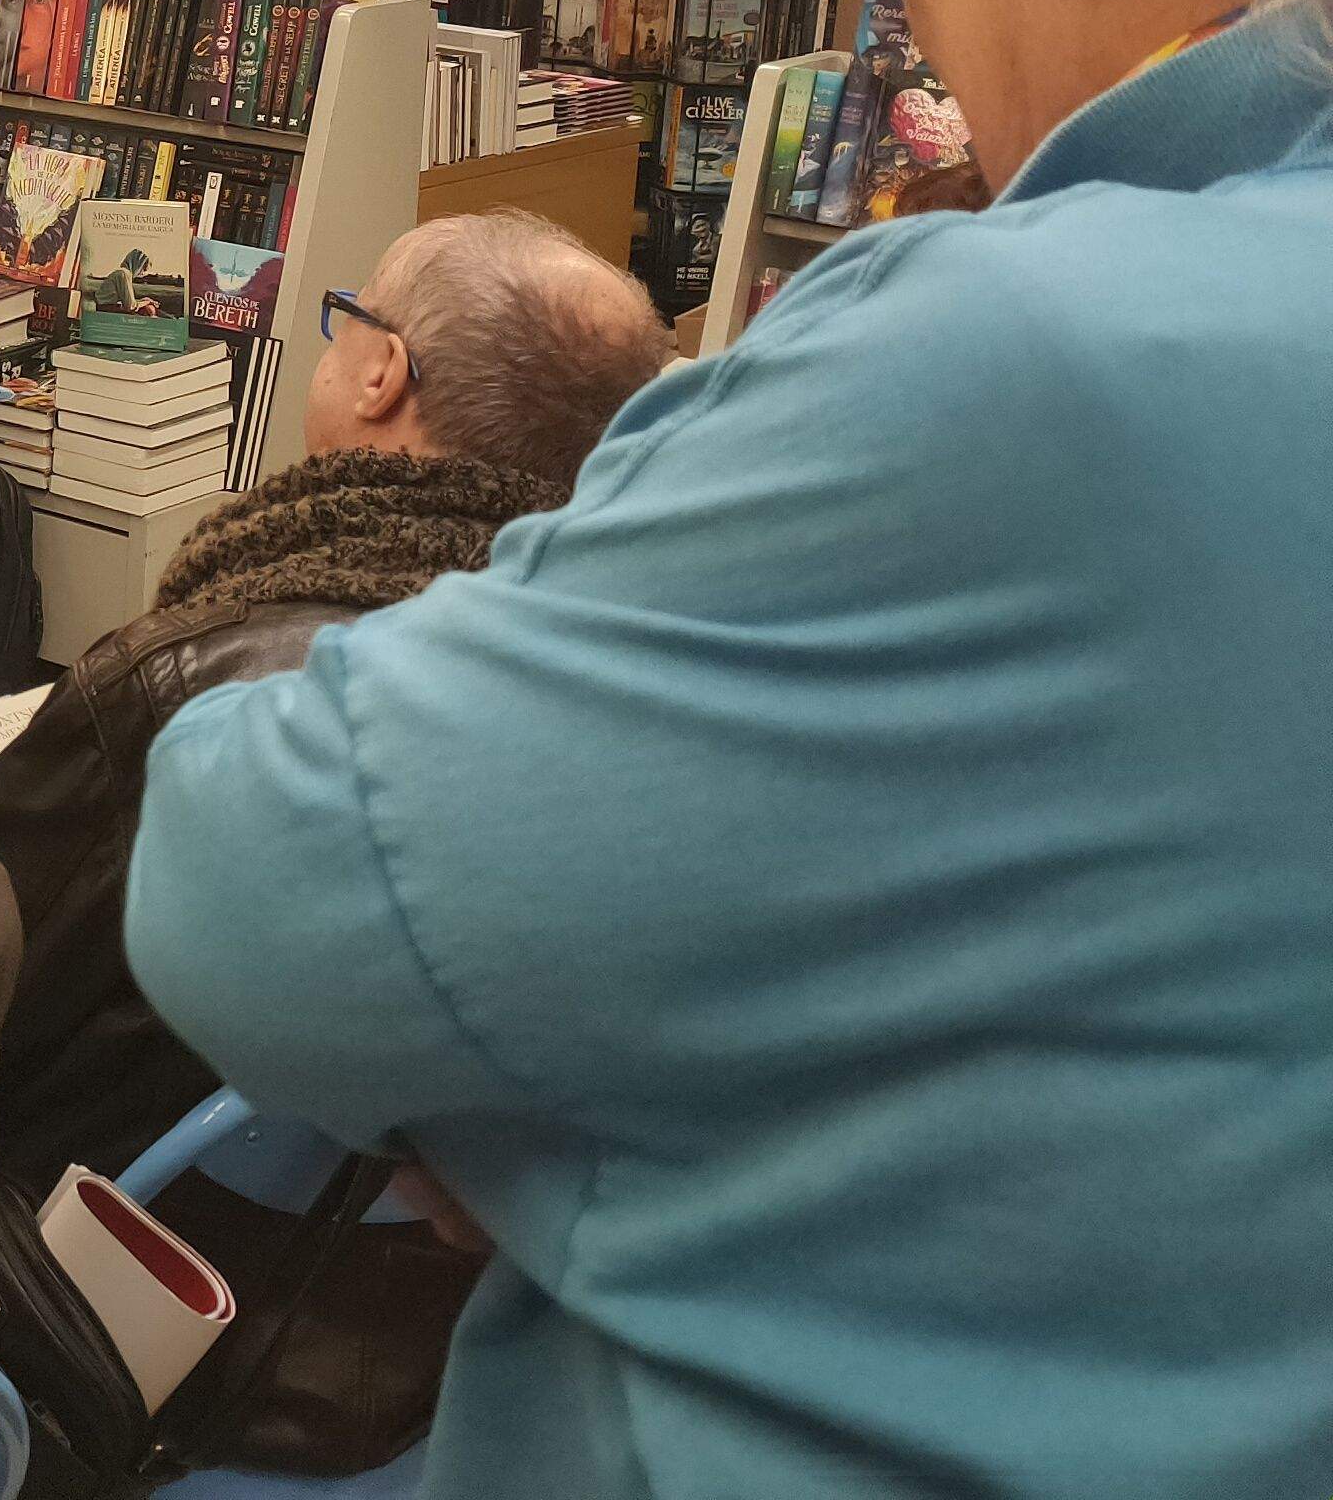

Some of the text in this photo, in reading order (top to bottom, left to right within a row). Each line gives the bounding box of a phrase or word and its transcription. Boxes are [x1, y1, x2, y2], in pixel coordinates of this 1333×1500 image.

[12, 177, 74, 209] MEDIANOCHE
[92, 211, 175, 226] MONTSE BARDERI
[204, 290, 249, 309] CUENTOS
[192, 296, 260, 329] BERETH
